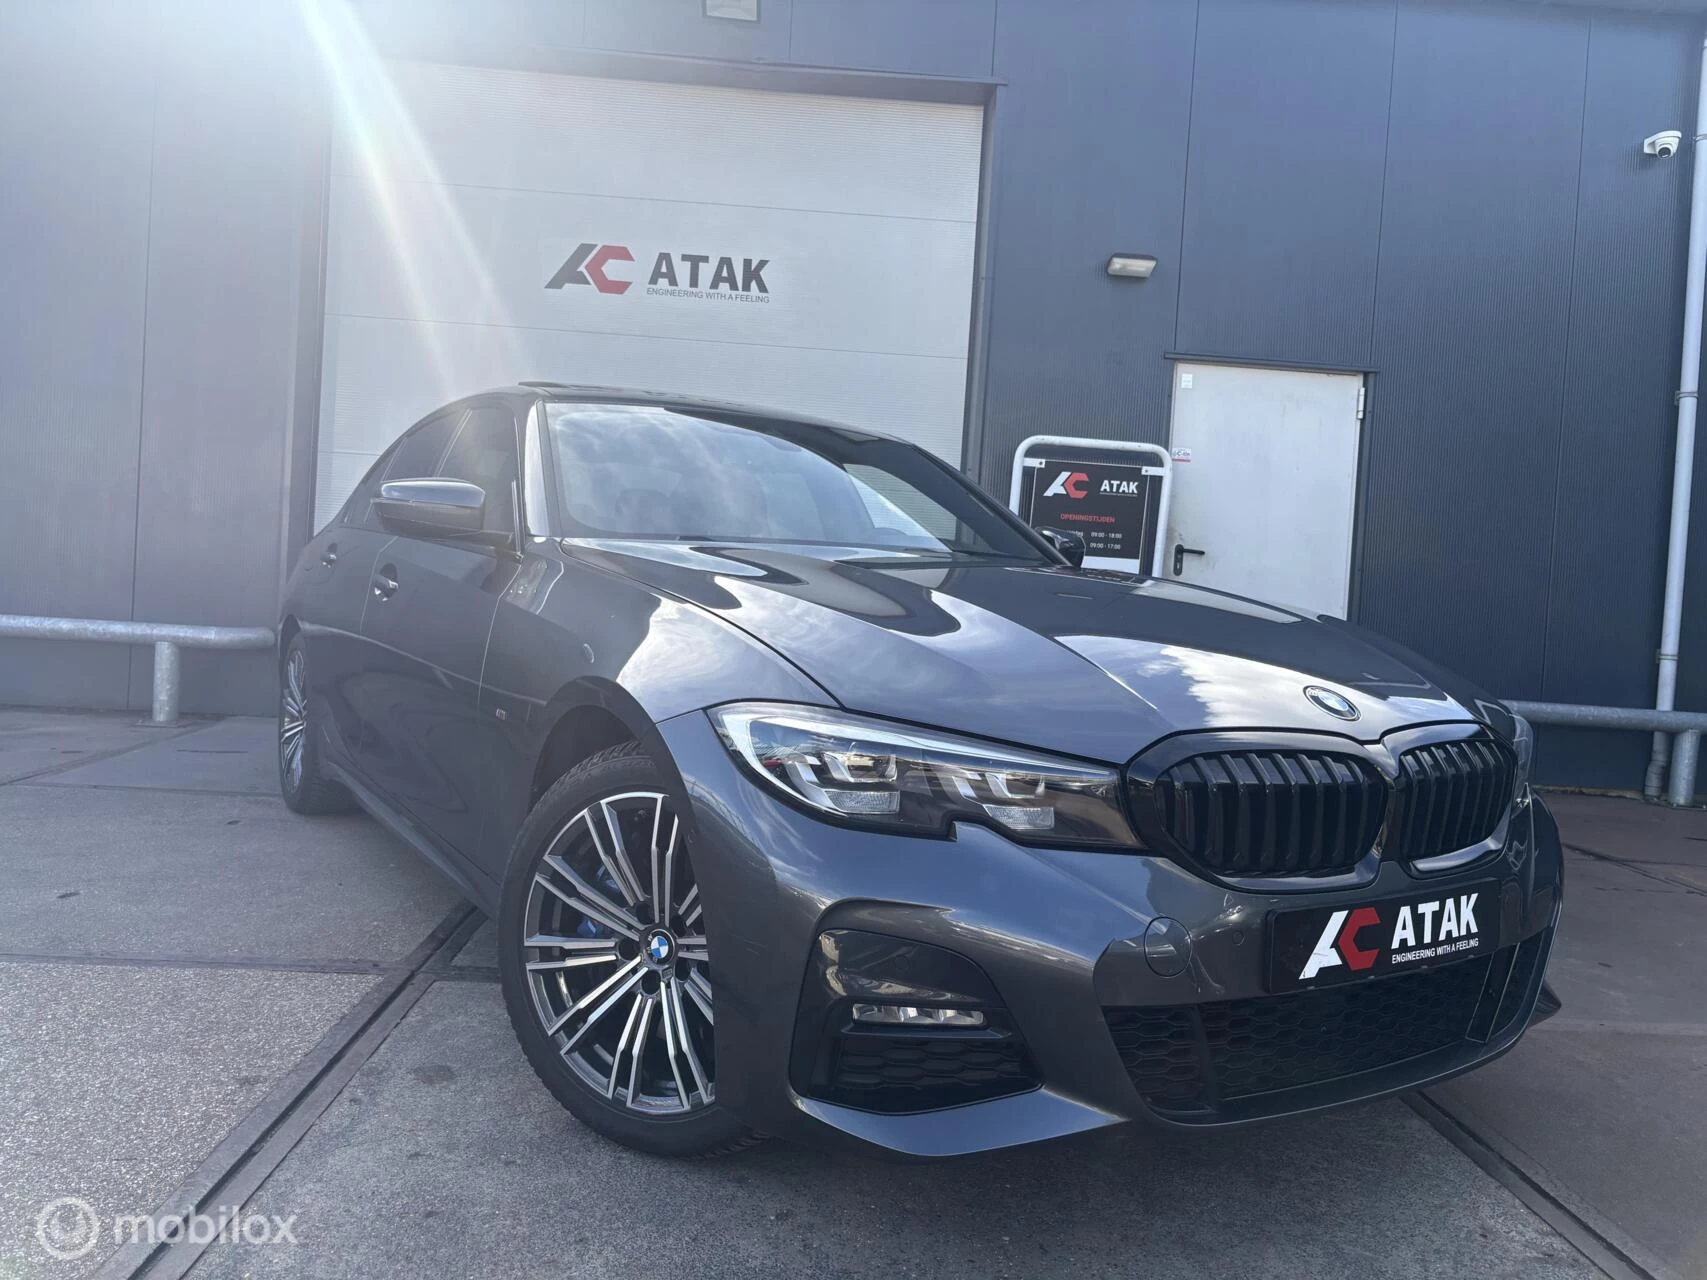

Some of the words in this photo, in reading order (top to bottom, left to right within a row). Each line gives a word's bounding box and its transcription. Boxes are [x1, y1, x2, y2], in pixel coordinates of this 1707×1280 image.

[648, 252, 770, 294] ATAK
[646, 287, 704, 299] ENGINEERING
[705, 291, 726, 301] WITH
[727, 293, 734, 301] A
[734, 293, 770, 304] FEELING
[1100, 479, 1139, 494] ATAK
[1391, 893, 1479, 950] ATAK
[1391, 948, 1436, 964] ENGINEERING
[1436, 944, 1451, 956] WITH
[1456, 937, 1479, 951] FEELING
